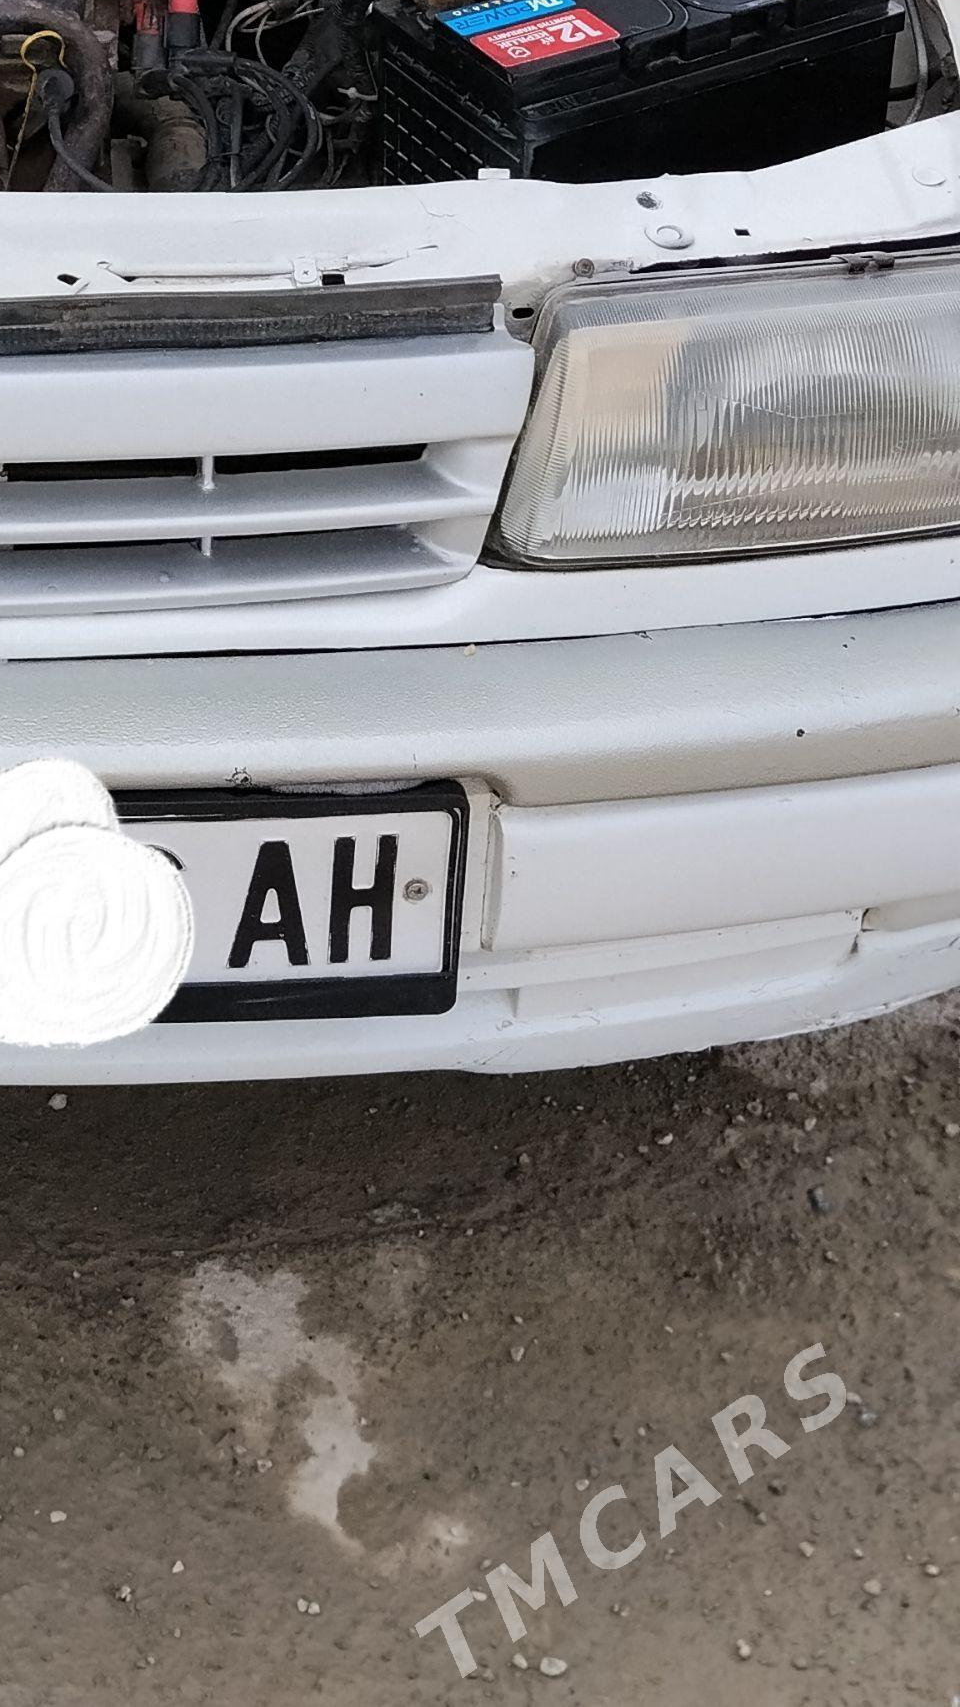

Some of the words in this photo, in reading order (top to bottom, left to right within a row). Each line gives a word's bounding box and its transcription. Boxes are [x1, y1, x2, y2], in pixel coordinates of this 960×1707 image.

[536, 14, 576, 28] MONTHS
[547, 19, 603, 44] 12
[487, 23, 538, 41] WARRANTY
[226, 833, 399, 968] AH
